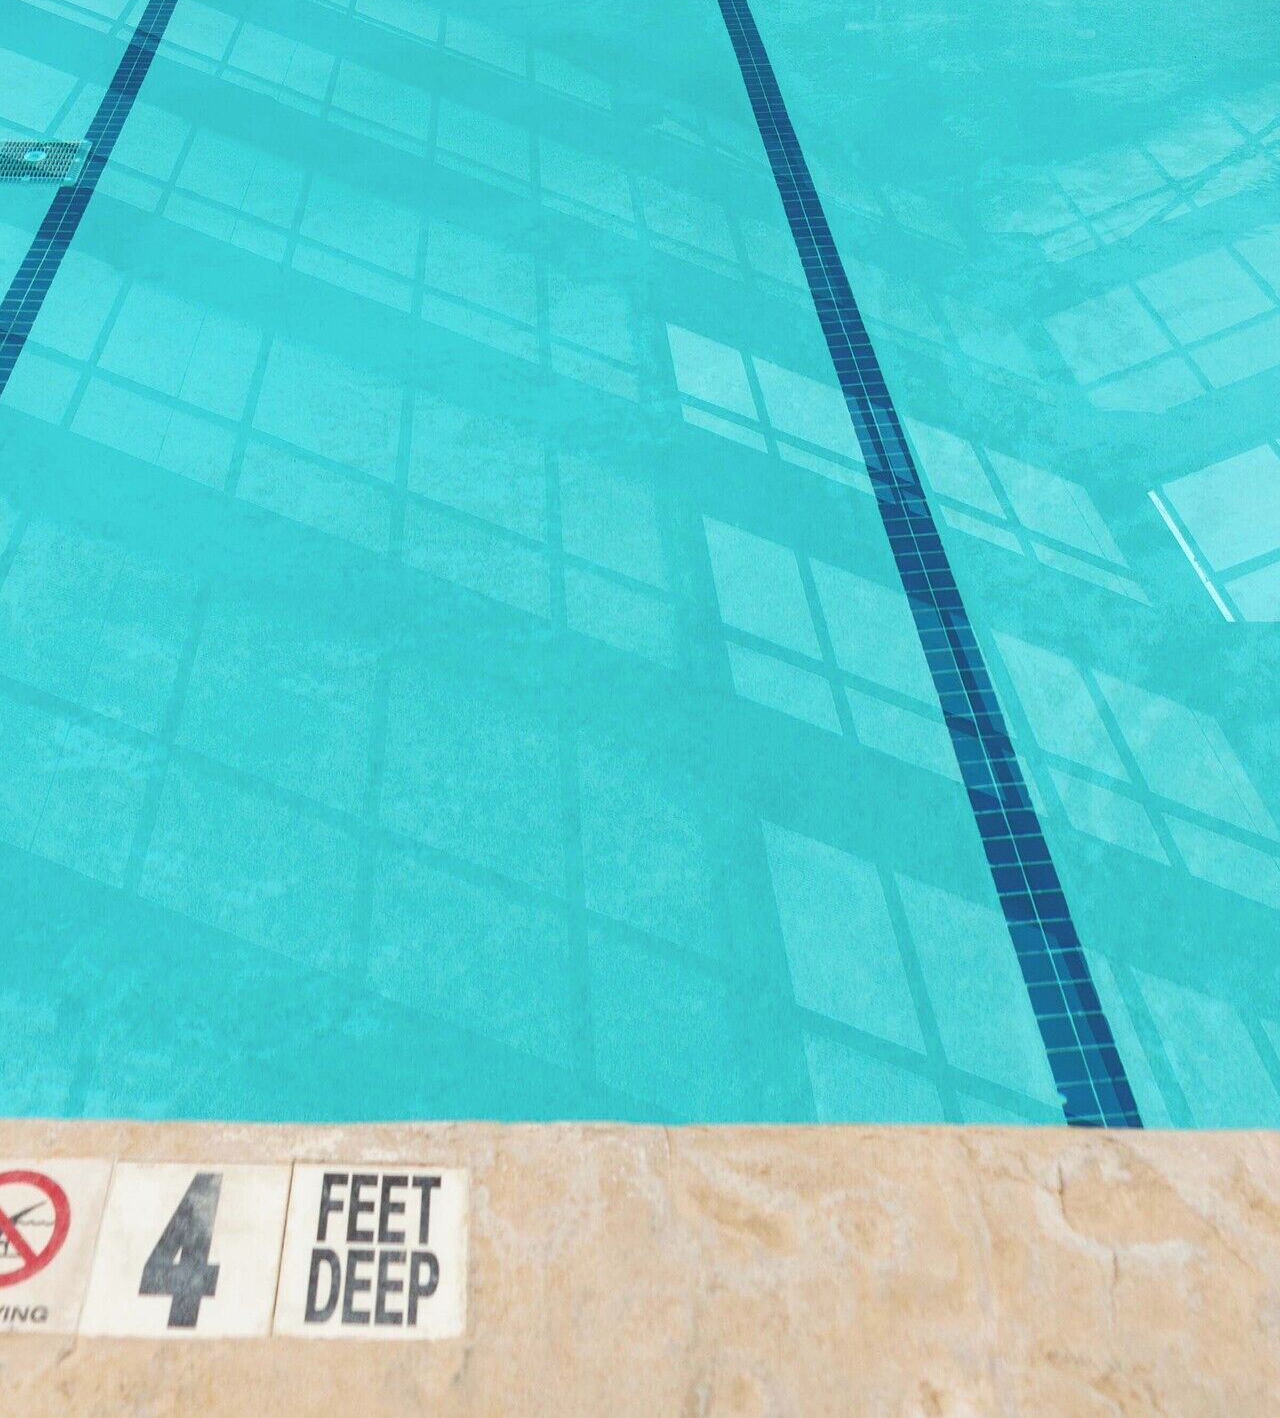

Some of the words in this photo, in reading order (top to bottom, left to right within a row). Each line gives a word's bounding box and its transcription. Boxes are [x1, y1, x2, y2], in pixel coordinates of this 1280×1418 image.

[317, 1172, 442, 1245] FEET
[138, 1172, 223, 1329] 4
[304, 1248, 441, 1328] DEEP
